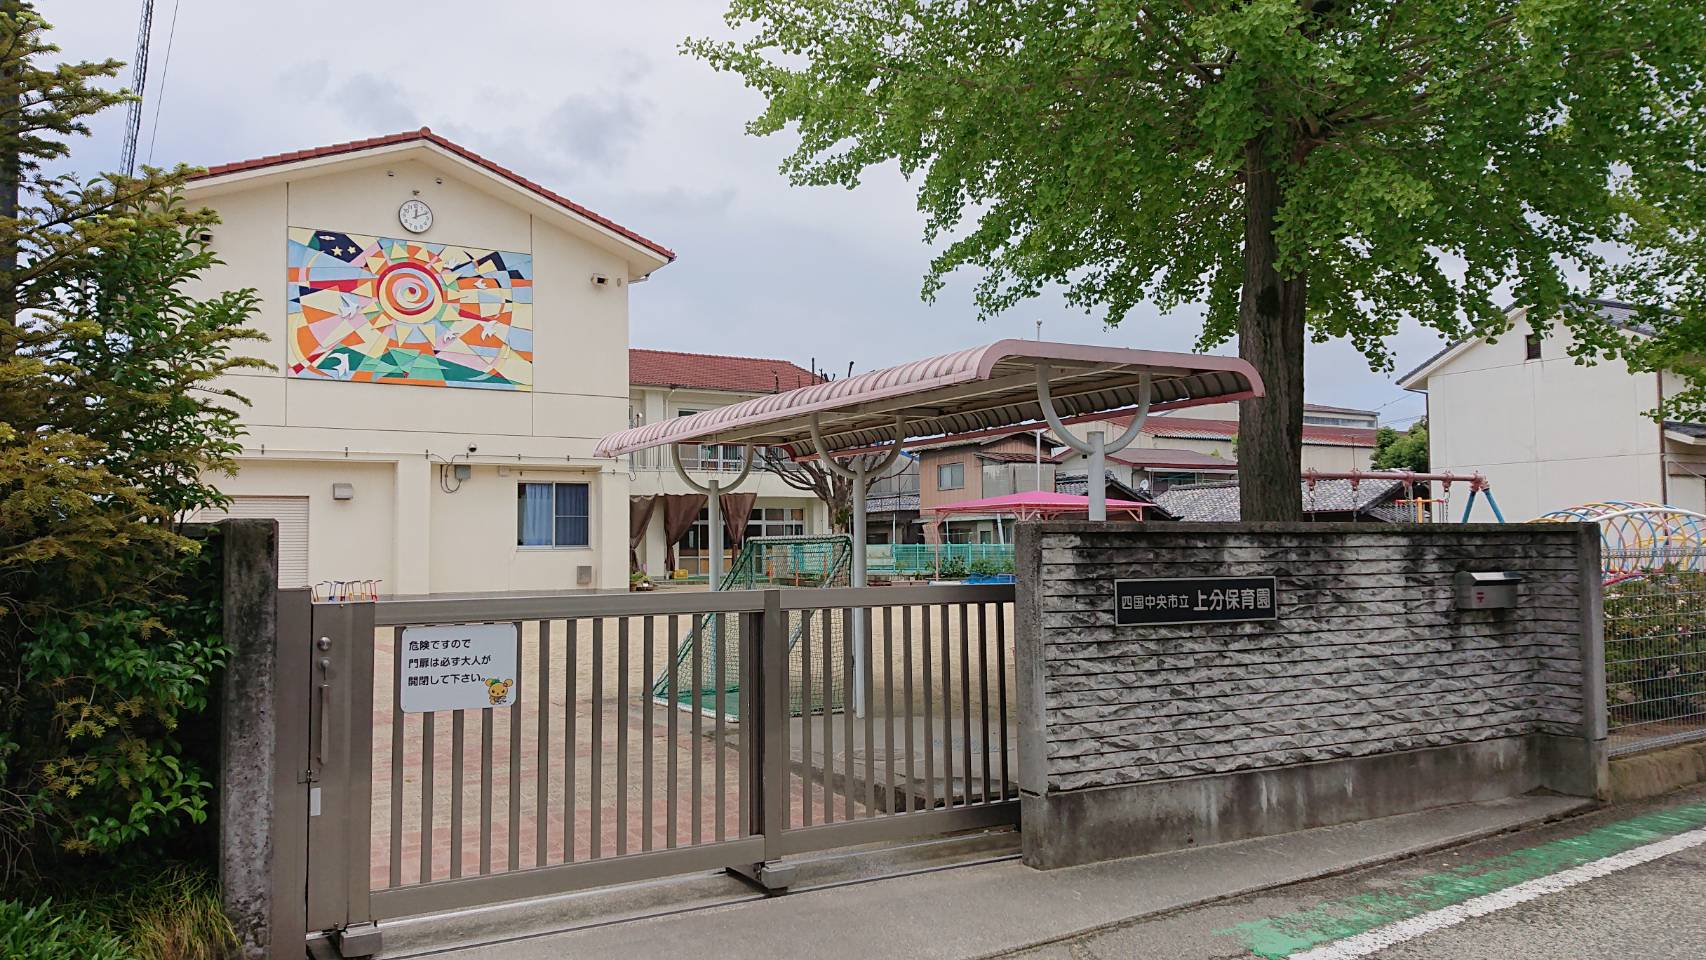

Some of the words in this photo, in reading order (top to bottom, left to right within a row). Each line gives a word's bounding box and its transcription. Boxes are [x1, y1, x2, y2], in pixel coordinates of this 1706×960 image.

[1121, 594, 1190, 610] 四国中央市立
[1193, 588, 1271, 611] 上分保育園
[408, 639, 471, 651] 危険ですので
[408, 655, 491, 669] 門扉は必ず大人が
[407, 673, 486, 687] 開閉して下さい。
